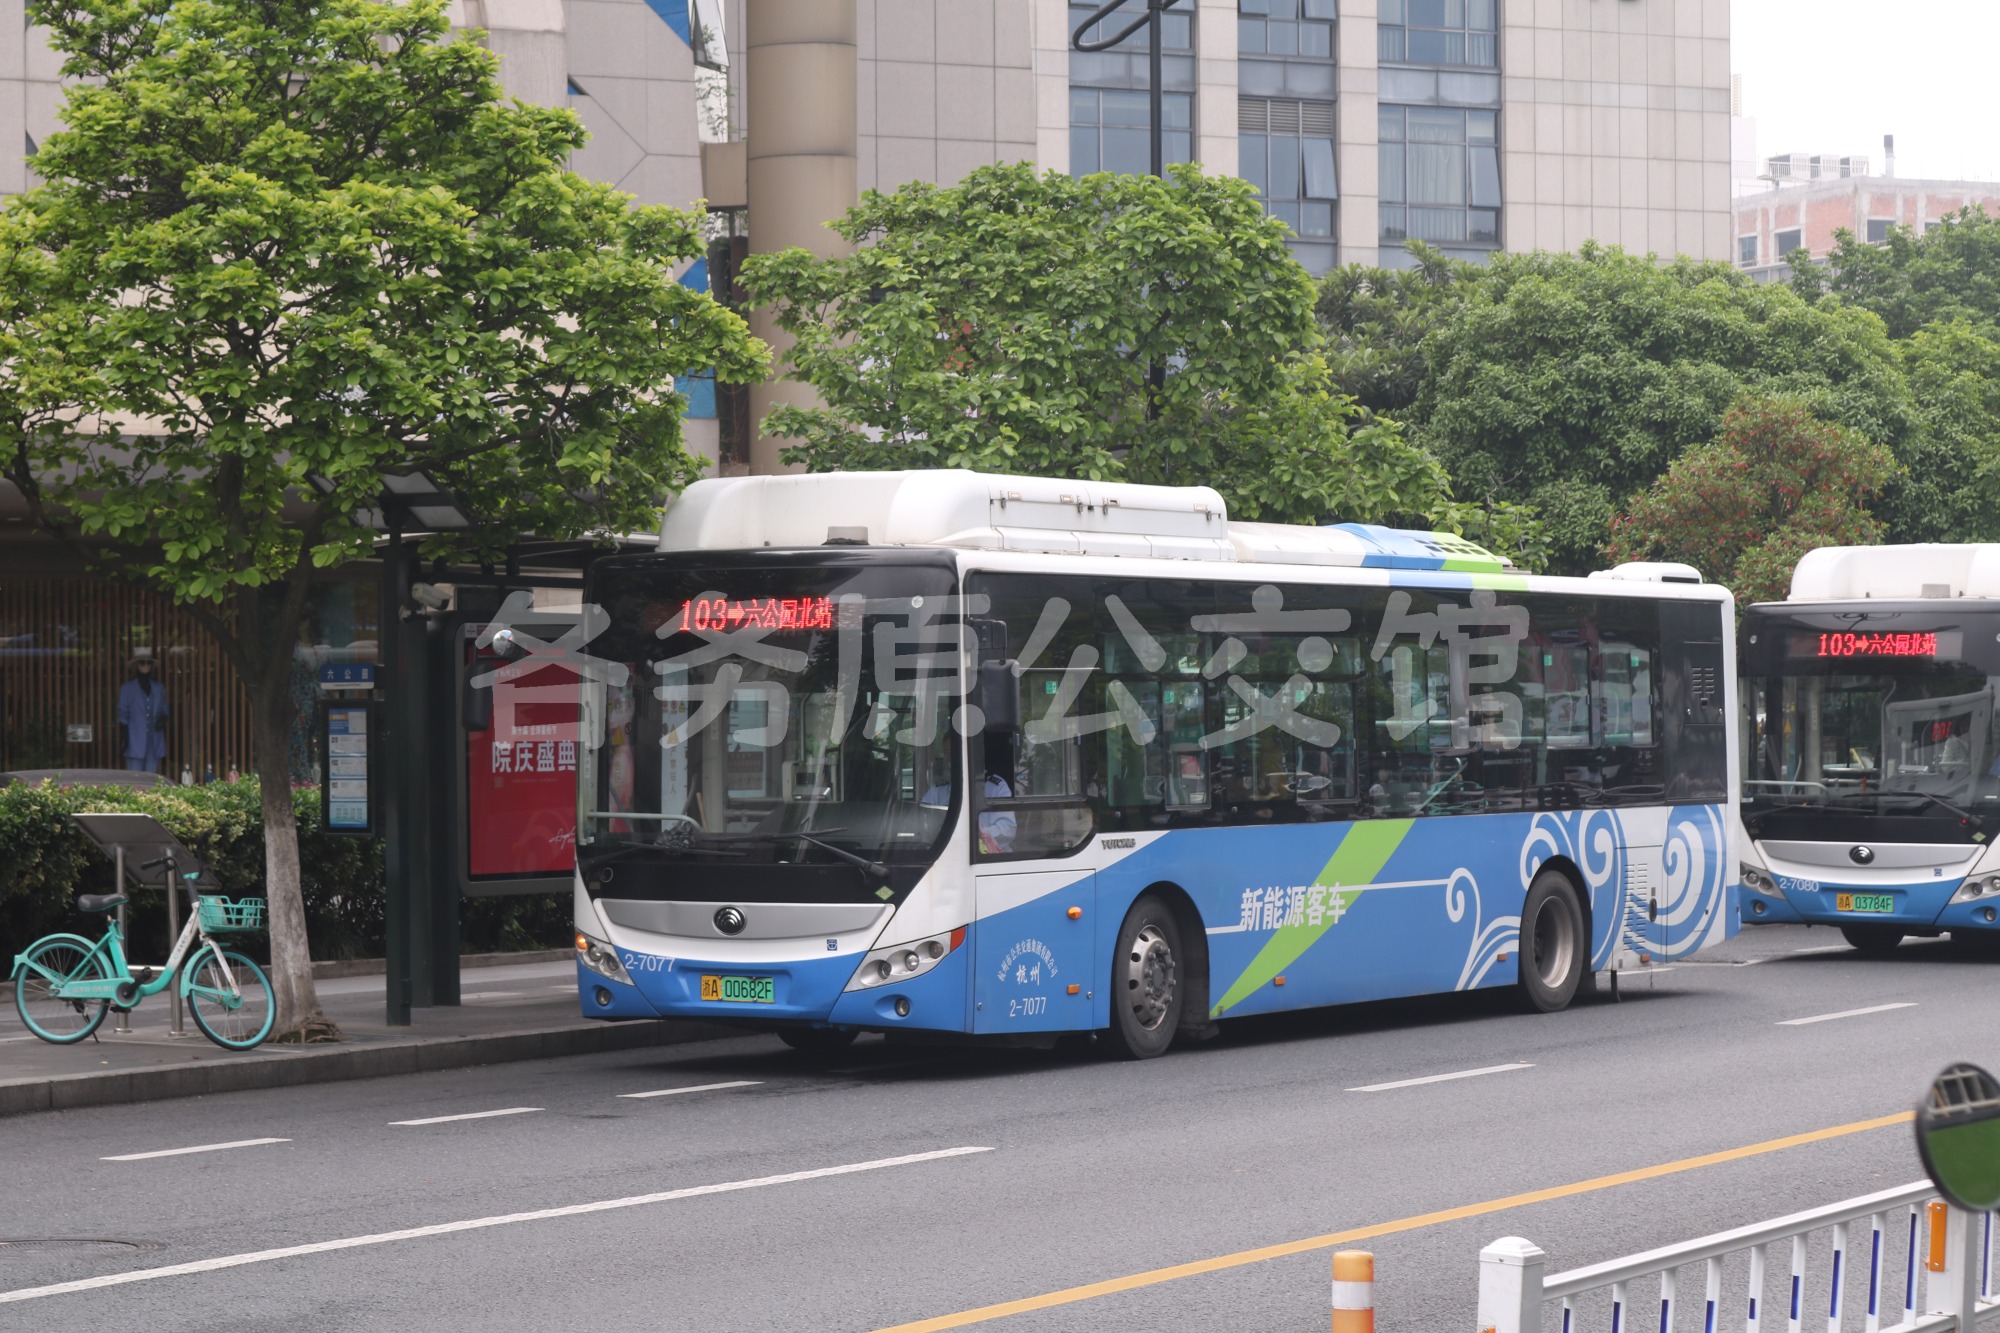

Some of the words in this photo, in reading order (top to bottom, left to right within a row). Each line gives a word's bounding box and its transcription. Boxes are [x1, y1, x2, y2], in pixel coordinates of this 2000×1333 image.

[680, 599, 728, 631] 103
[744, 597, 832, 629] 六公园北站
[1817, 633, 1856, 656] 103
[1868, 632, 1937, 656] 六公园北站
[491, 740, 577, 773] 院庆盛典
[1780, 878, 1819, 892] 2-7080
[1240, 881, 1346, 932] 新能源客车
[625, 953, 676, 972] 2-7077
[1016, 961, 1040, 986] 杭州
[1009, 997, 1047, 1017] 2-7077
